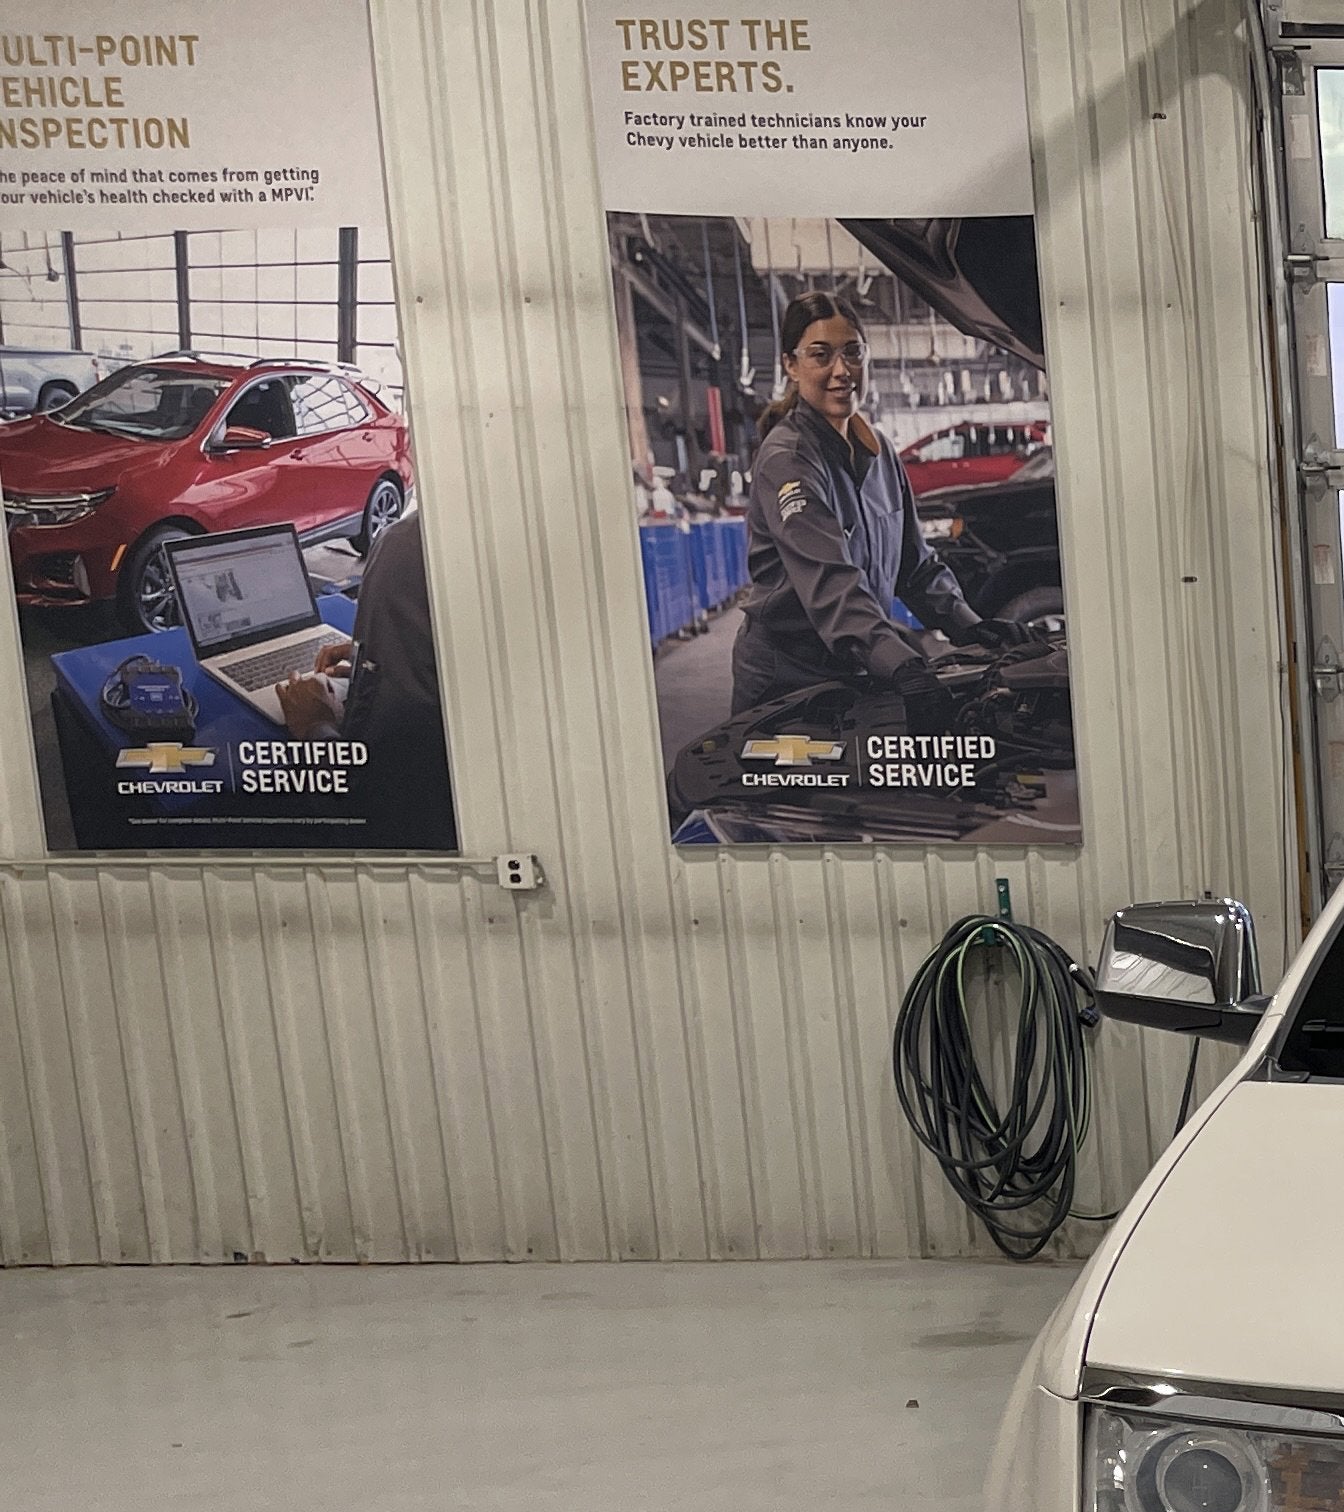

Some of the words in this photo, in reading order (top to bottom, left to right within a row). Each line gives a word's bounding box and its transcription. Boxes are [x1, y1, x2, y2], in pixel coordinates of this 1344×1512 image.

[615, 19, 729, 51] TRUST
[741, 19, 811, 51] THE
[2, 35, 199, 67] ULTI-POINT
[620, 60, 795, 93] EXPERTS.
[1, 76, 125, 108] EHICLE
[0, 117, 191, 149] NSPECTION
[624, 111, 685, 130] Factory
[690, 111, 747, 129] trained
[751, 112, 841, 129] technicians
[846, 112, 887, 129] know
[891, 114, 928, 131] your
[626, 131, 674, 150] Chevy
[679, 132, 735, 149] vehicle
[739, 132, 788, 149] better
[792, 133, 828, 149] than
[833, 136, 894, 152] anyone.
[0, 169, 16, 183] he
[22, 171, 66, 187] peace
[71, 168, 86, 183] of
[91, 168, 128, 183] mind
[132, 168, 163, 183] that
[169, 171, 218, 183] comes
[222, 168, 259, 182] from
[264, 167, 319, 185] getting
[1, 192, 25, 204] our
[30, 188, 95, 204] vehicle's
[100, 188, 148, 204] health
[152, 188, 215, 204] checked
[220, 188, 253, 203] with
[258, 191, 267, 202] a
[238, 741, 368, 766] CERTIFIED
[866, 735, 997, 760] CERTIFIED
[118, 780, 225, 795] CHEVROLET
[242, 769, 350, 794] SERVICE
[742, 773, 850, 788] CHEVROLET
[868, 764, 977, 788] SERVICE
